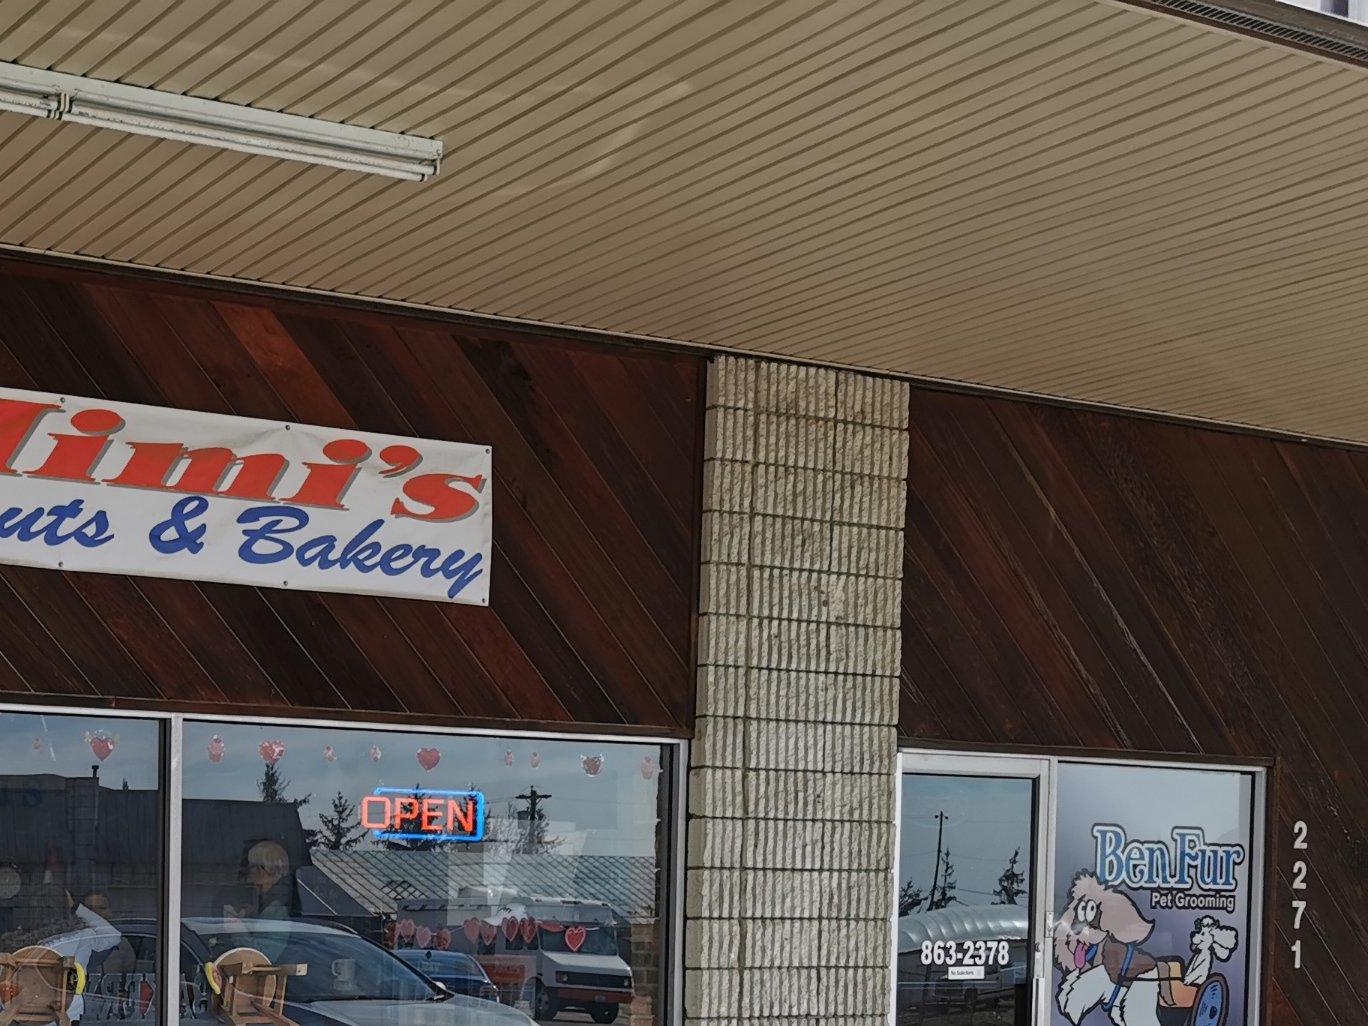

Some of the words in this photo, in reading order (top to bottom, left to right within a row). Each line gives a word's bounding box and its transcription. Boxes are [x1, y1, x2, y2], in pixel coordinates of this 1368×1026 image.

[148, 495, 209, 554] &
[236, 506, 483, 598] Bakery
[361, 796, 474, 833] OPEN
[1092, 824, 1170, 889] Ben
[1172, 827, 1245, 890] Fur
[1151, 892, 1173, 908] Pet
[1175, 893, 1235, 912] Grooming
[1291, 820, 1308, 969] 2271
[920, 940, 1010, 966] 863-2378
